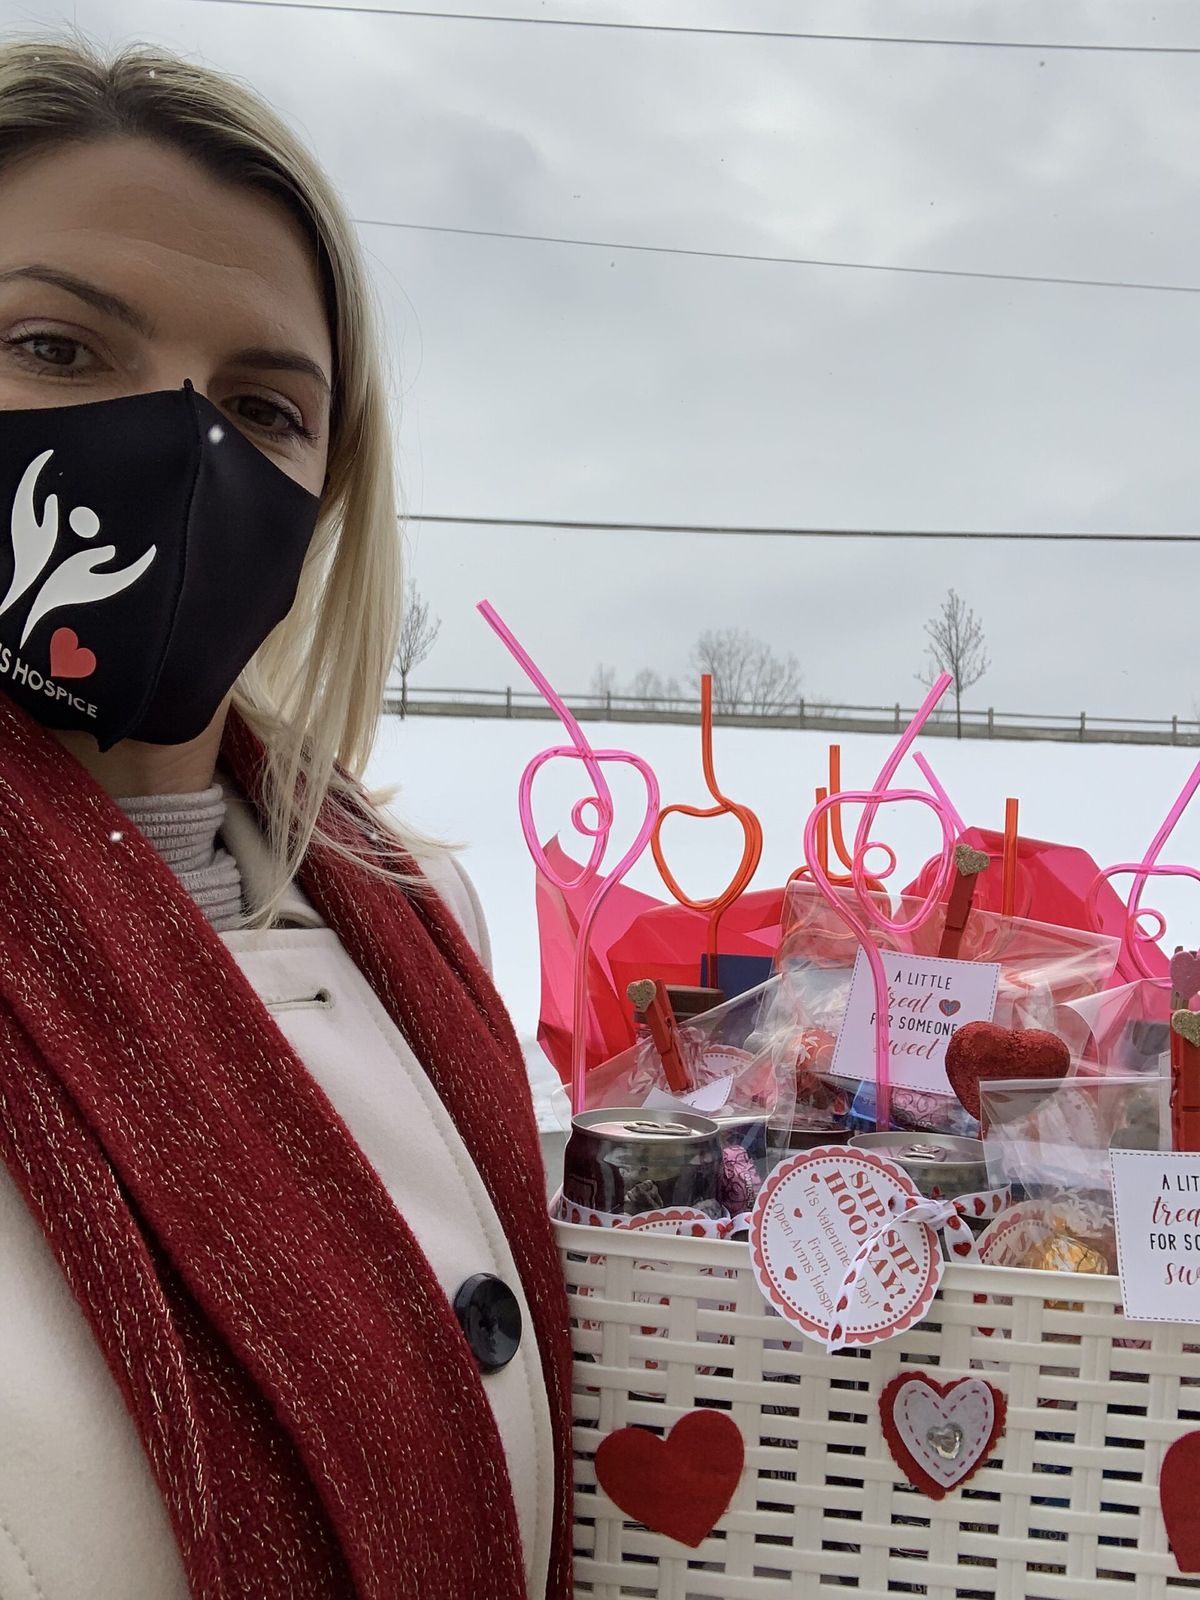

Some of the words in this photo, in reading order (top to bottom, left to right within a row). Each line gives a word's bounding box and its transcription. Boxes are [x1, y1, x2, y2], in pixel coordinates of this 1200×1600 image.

[0, 642, 12, 673] S
[12, 657, 98, 718] HOSPICE
[894, 970, 901, 983] A
[907, 972, 953, 990] LITTLE
[887, 986, 933, 1013] reat
[870, 1012, 893, 1028] FR
[898, 1016, 958, 1036] SOMEONE
[874, 1038, 940, 1060] weet
[1162, 1174, 1170, 1190] A
[1177, 1175, 1200, 1192] LIT
[849, 1171, 886, 1228] SIP,
[882, 1229, 919, 1274] SIP
[1151, 1195, 1200, 1227] trea
[803, 1185, 819, 1207] It's
[816, 1207, 850, 1268] Valentine
[855, 1277, 880, 1309] Day!
[1150, 1233, 1176, 1250] FOR
[1184, 1233, 1200, 1251] SO
[772, 1203, 794, 1237] Open
[790, 1239, 814, 1274] Arms
[810, 1275, 834, 1318] Hospi
[1164, 1262, 1200, 1285] sw
